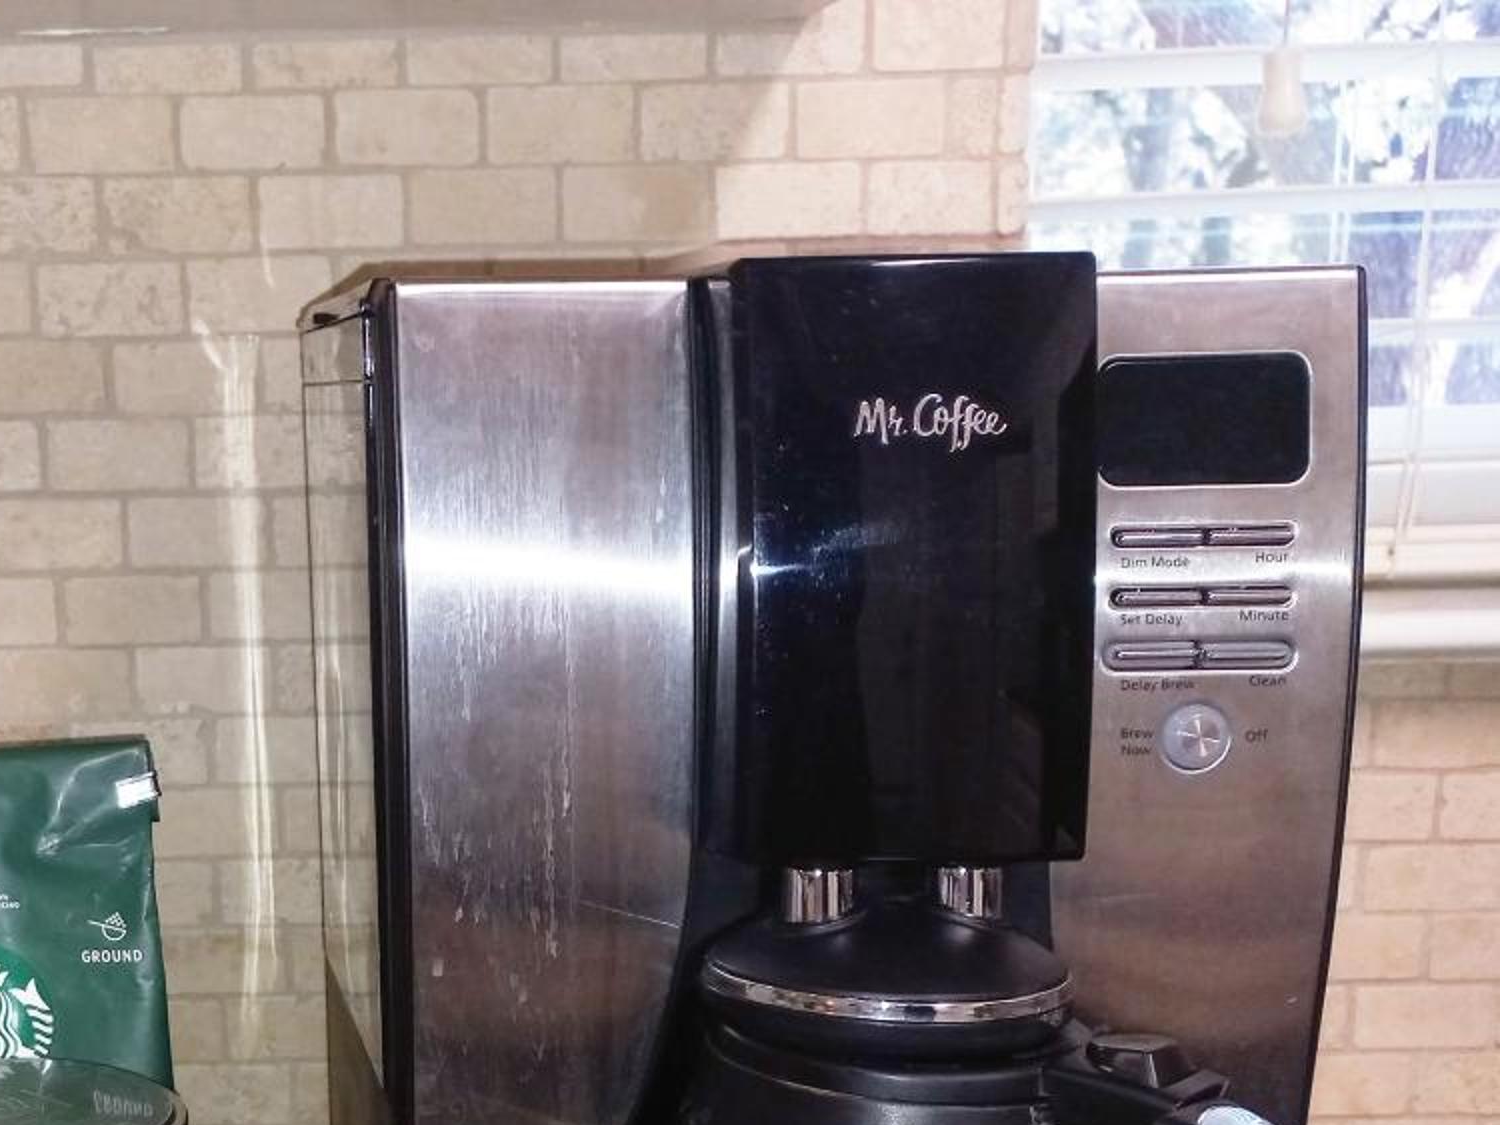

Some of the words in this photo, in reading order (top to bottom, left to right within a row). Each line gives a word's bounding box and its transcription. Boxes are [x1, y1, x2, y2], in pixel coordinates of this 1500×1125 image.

[853, 397, 907, 445] Mr.
[913, 393, 1007, 452] Coffee
[1120, 557, 1147, 569] Dim
[1151, 556, 1190, 568] Mode
[1255, 552, 1289, 563] Hour
[1121, 614, 1142, 625] Set
[1145, 614, 1183, 626] Delay
[1239, 611, 1289, 622] Minute
[1120, 680, 1157, 692] Delay
[1161, 679, 1194, 690] Brew
[1249, 675, 1287, 687] Clean
[1121, 728, 1154, 740] Brew
[1245, 729, 1268, 742] Off
[81, 949, 143, 965] GROUND
